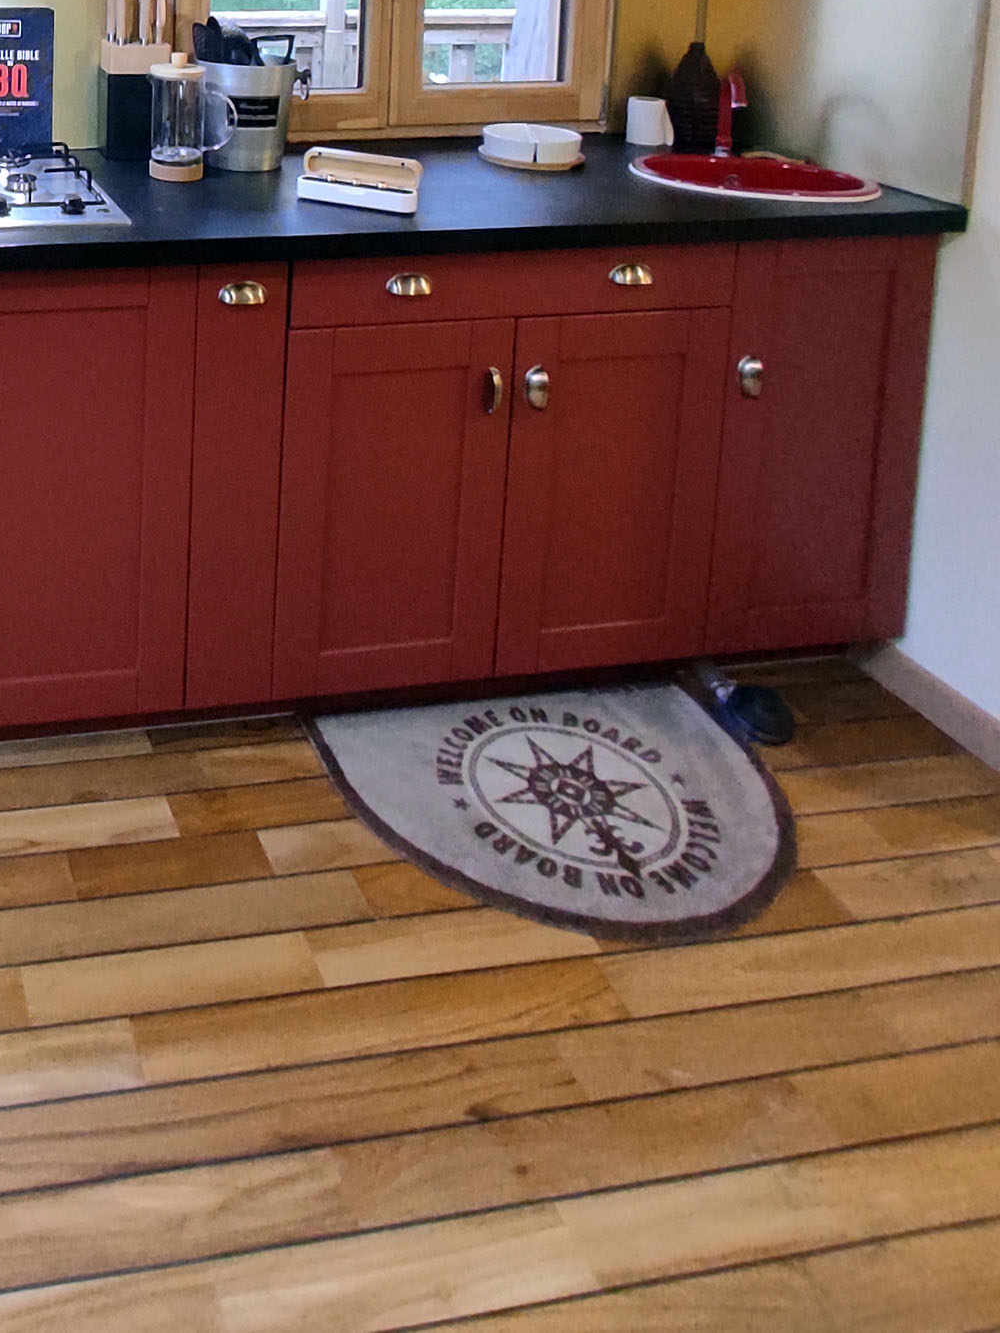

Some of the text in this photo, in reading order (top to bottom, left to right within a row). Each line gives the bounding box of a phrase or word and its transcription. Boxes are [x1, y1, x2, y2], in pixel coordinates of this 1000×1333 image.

[16, 49, 40, 61] BIBLE
[436, 706, 662, 786] WELCOME ON BOARD
[473, 799, 721, 899] WELCOME ON BOARD
